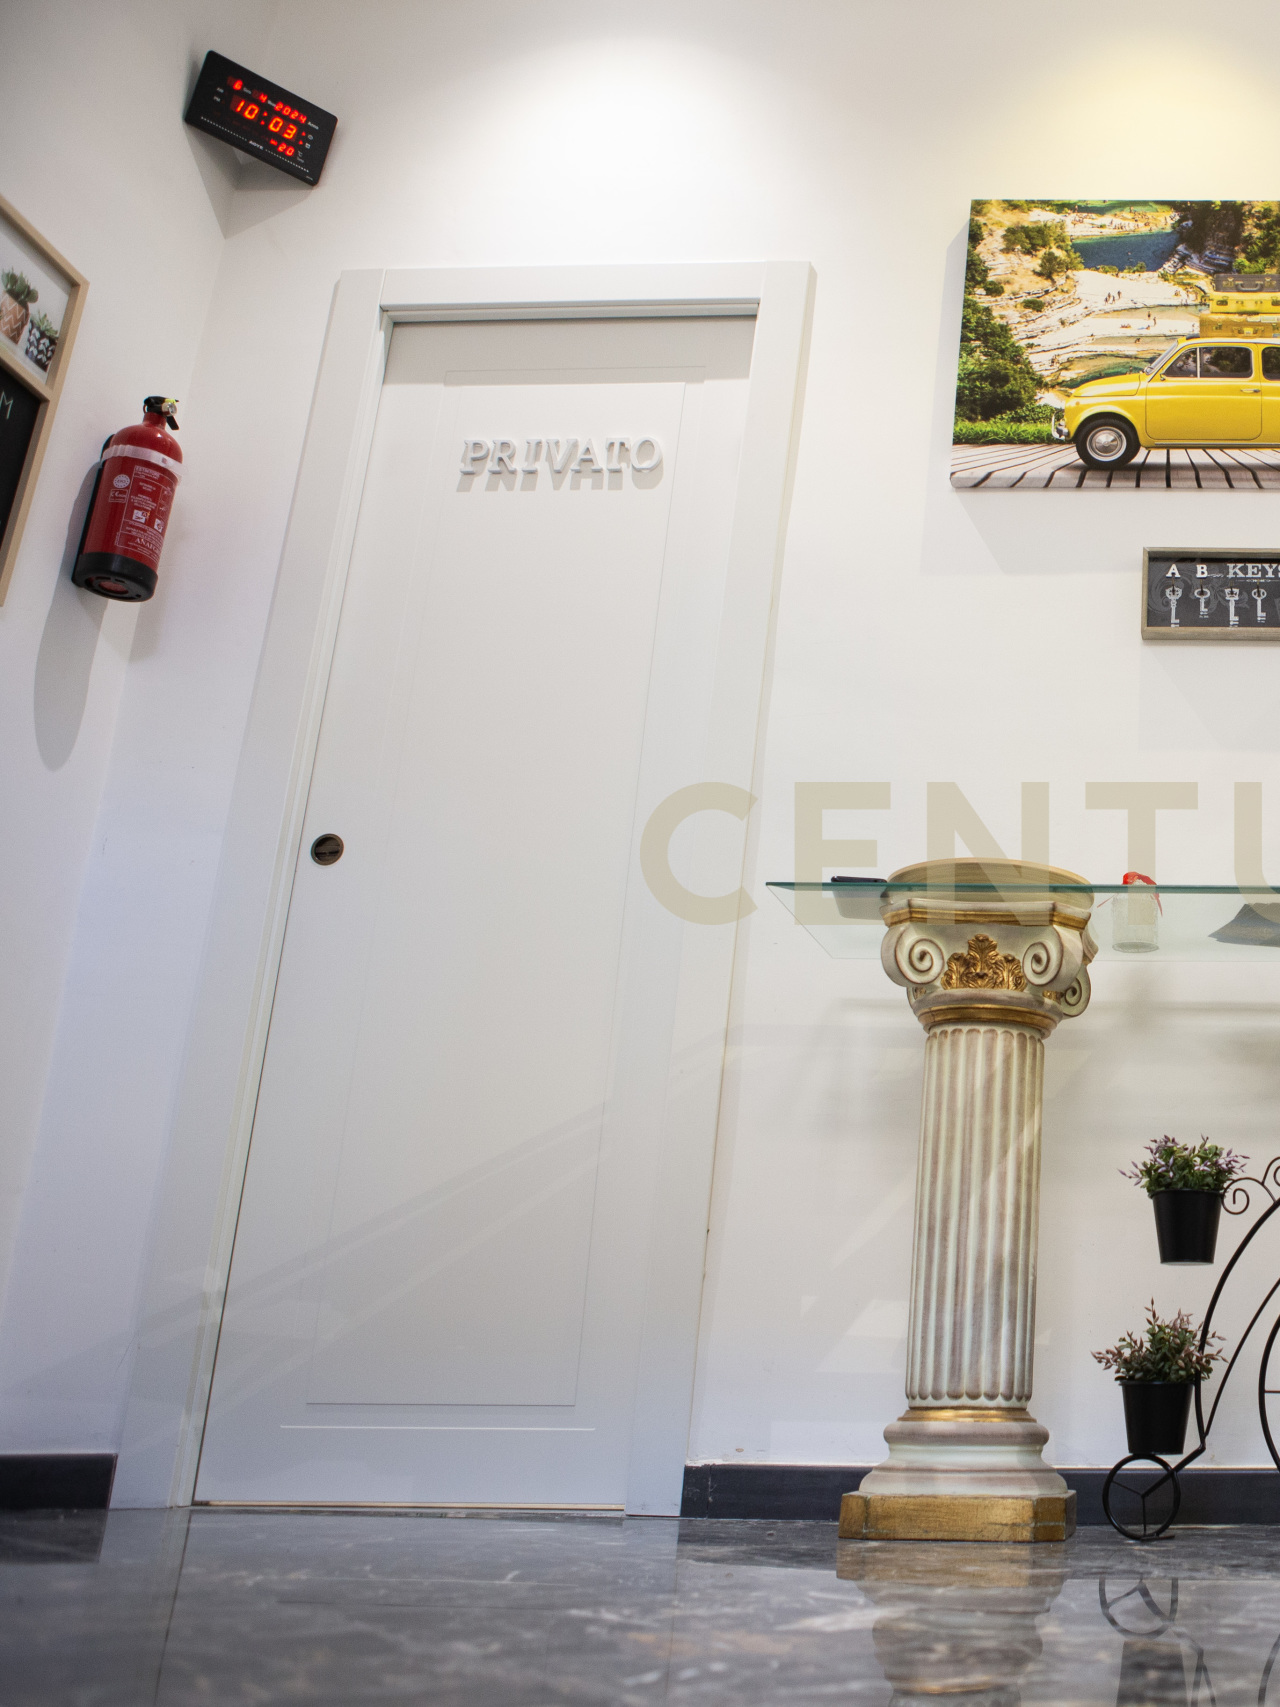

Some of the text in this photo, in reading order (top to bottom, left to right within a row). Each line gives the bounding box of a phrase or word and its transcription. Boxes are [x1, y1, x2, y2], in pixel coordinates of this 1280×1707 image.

[233, 79, 243, 91] 6
[259, 93, 268, 104] 4
[275, 101, 307, 125] 2024
[235, 100, 298, 140] 10:03
[460, 436, 663, 475] PRIVATO
[1166, 564, 1181, 578] A
[1196, 564, 1208, 578] B
